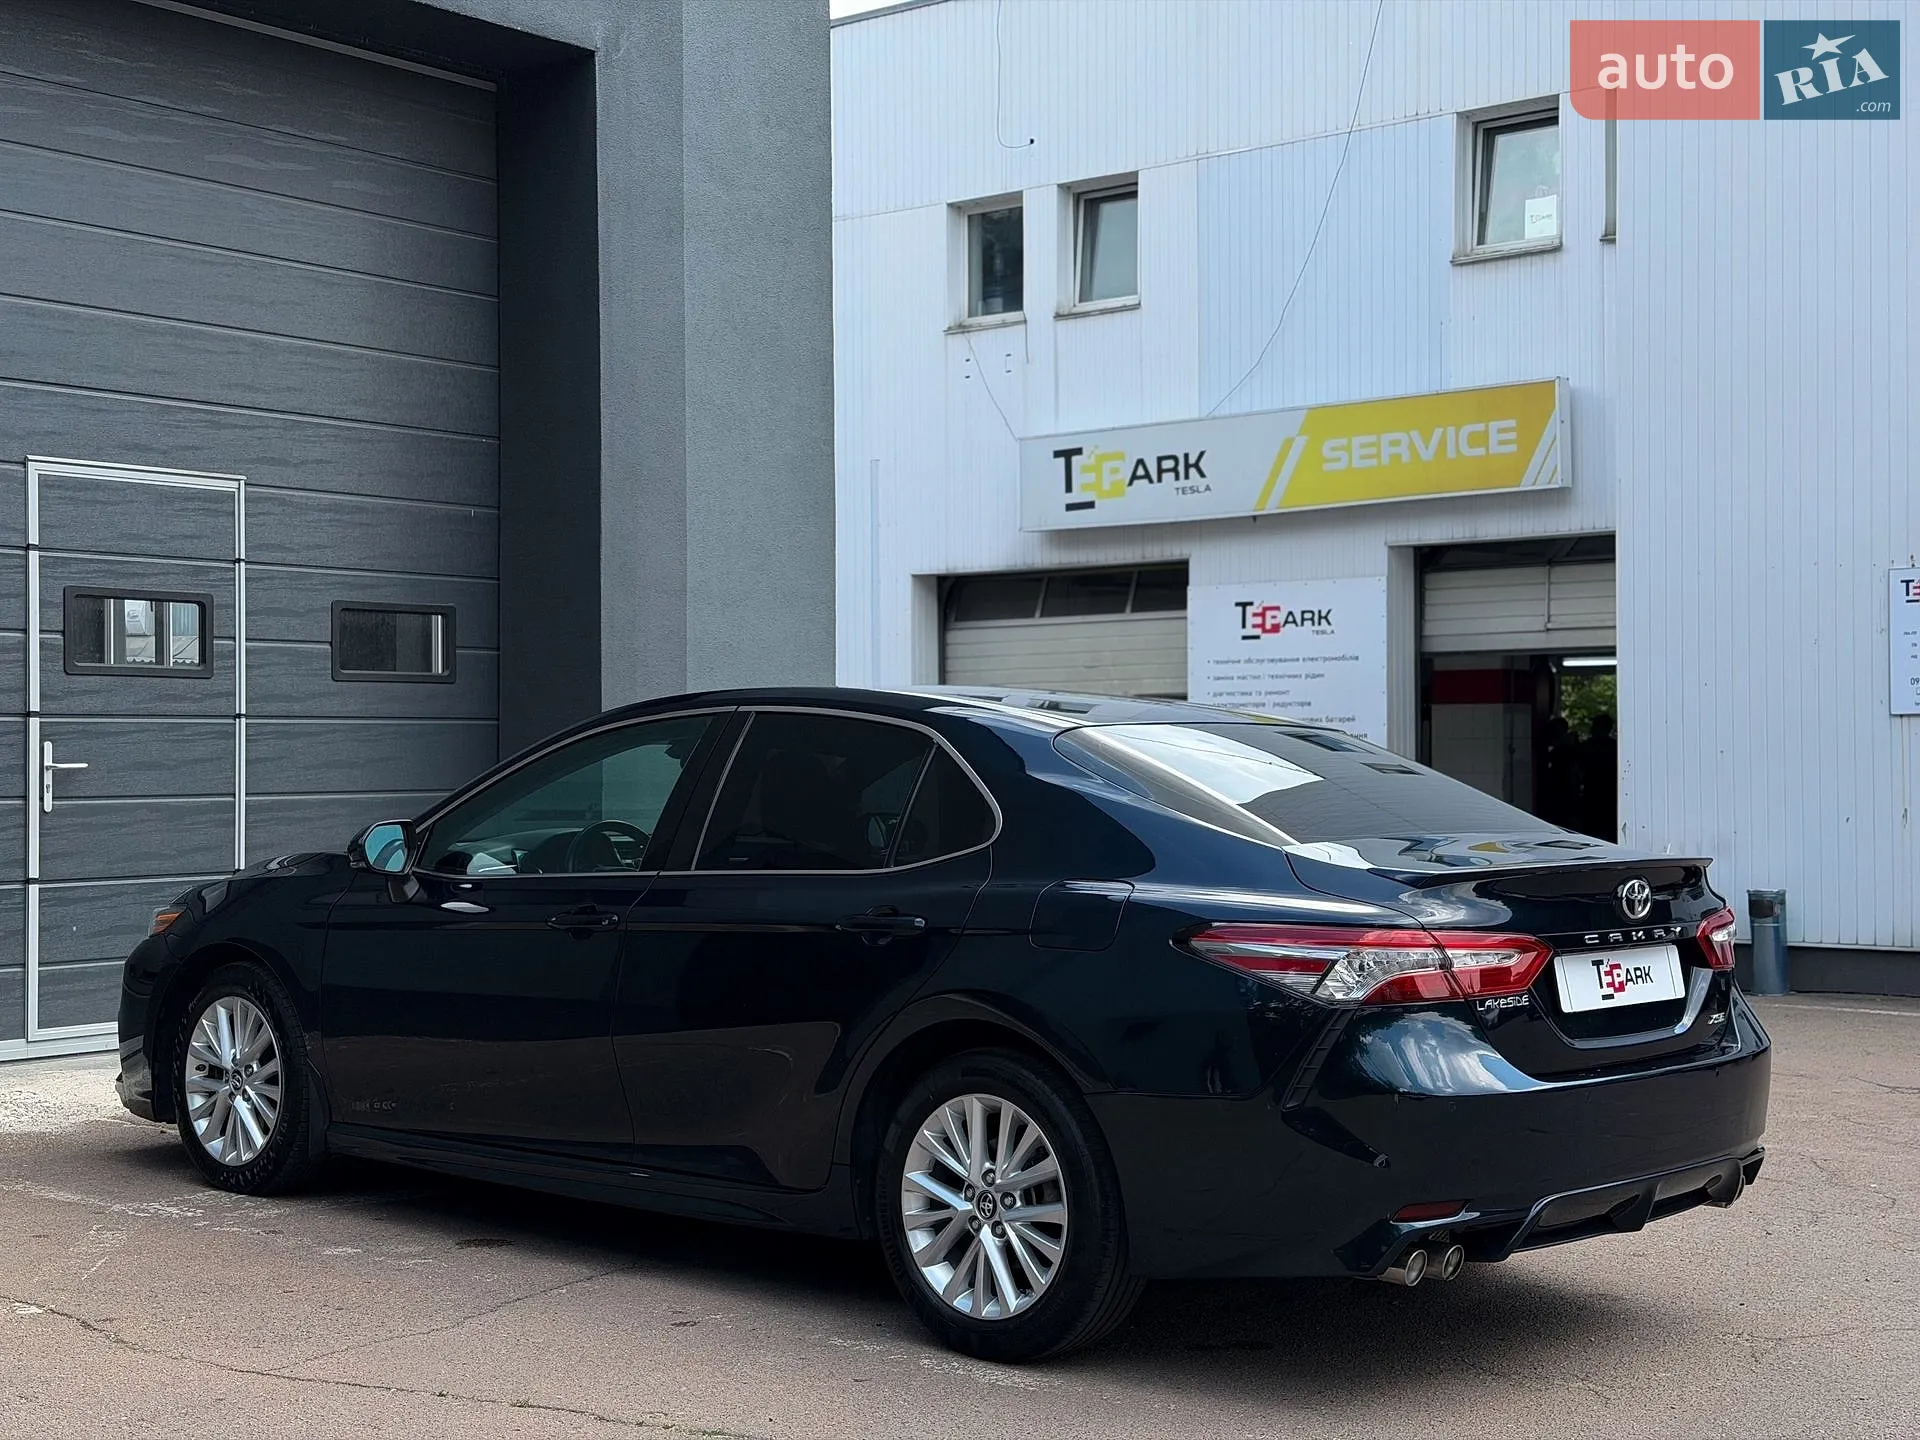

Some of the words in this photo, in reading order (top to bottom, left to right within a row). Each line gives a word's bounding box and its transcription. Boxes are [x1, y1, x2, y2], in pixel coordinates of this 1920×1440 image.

[1322, 419, 1518, 472] SERVICE
[1174, 484, 1212, 496] TESLA
[1312, 629, 1335, 637] TESLA
[1584, 926, 1682, 944] CAMRY
